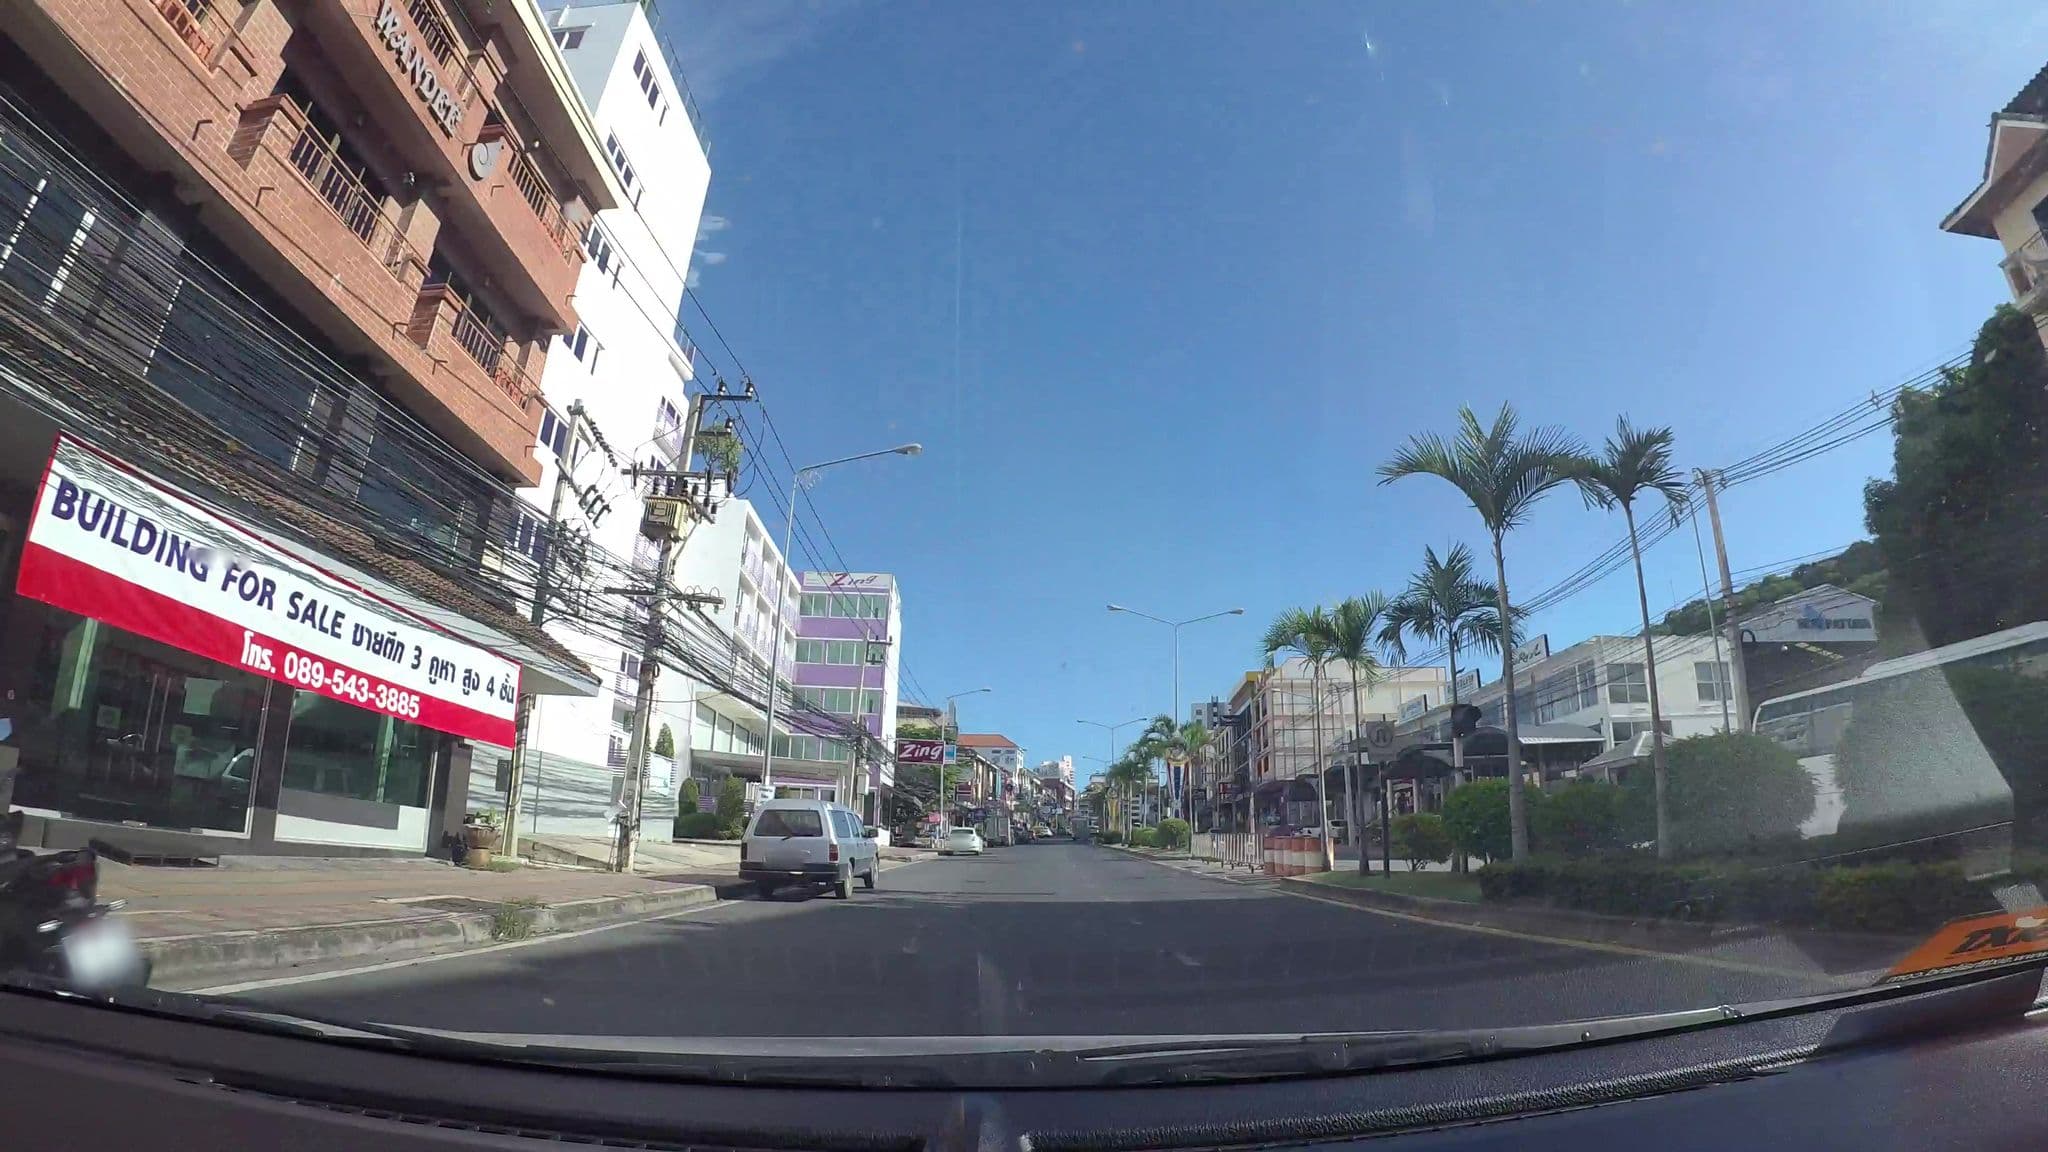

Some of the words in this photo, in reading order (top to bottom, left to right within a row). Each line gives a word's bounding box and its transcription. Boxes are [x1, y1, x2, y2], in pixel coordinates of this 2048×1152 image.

[51, 477, 208, 582] BUILDING
[221, 562, 277, 611] FOR
[286, 591, 346, 639] SALE
[352, 622, 406, 664] ขายตึก
[411, 645, 422, 670] 3
[428, 656, 456, 685] คูหา
[462, 668, 480, 696] สูง
[486, 676, 495, 697] 4
[499, 673, 515, 705] ชั้น
[241, 631, 276, 674] โทร.
[284, 651, 420, 718] 089-543-3885
[899, 744, 943, 760] Zing
